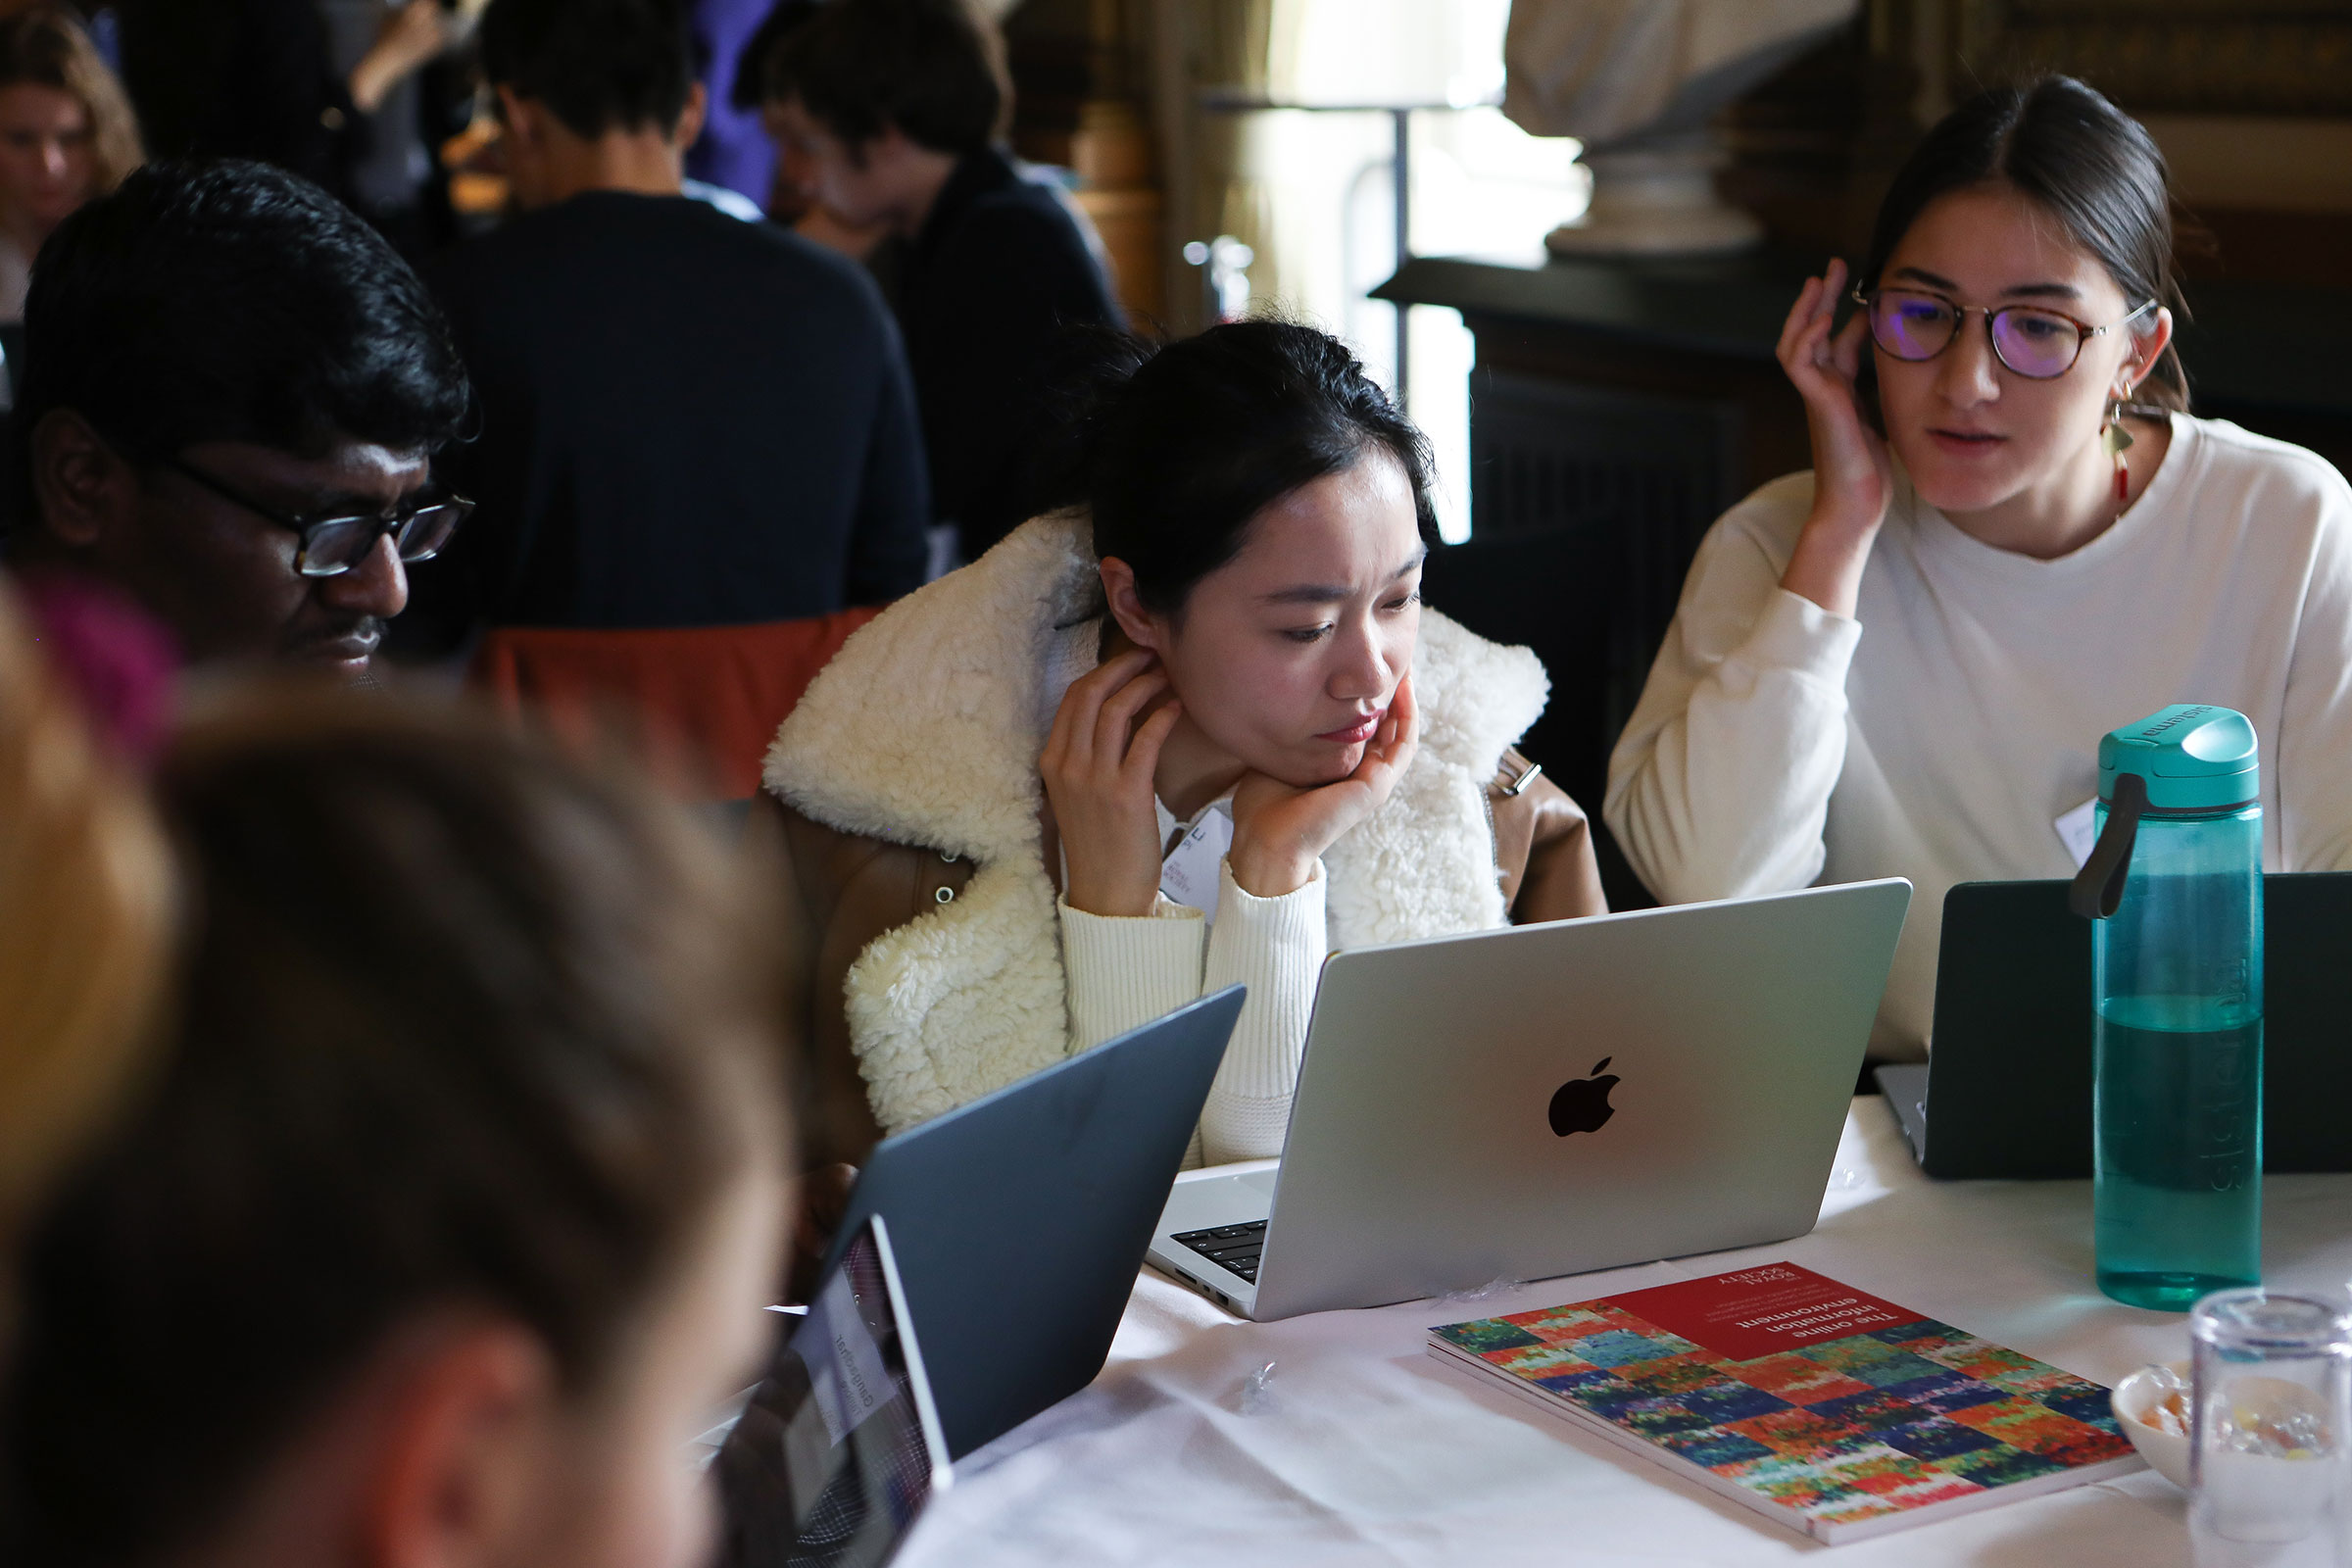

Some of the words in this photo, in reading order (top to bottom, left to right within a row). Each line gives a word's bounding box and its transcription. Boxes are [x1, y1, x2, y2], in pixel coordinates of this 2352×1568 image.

[2141, 706, 2213, 737] sistema
[1736, 1298, 1858, 1329] environment
[1765, 1304, 1881, 1333] information
[1855, 1311, 1898, 1325] The
[1791, 1320, 1853, 1339] online
